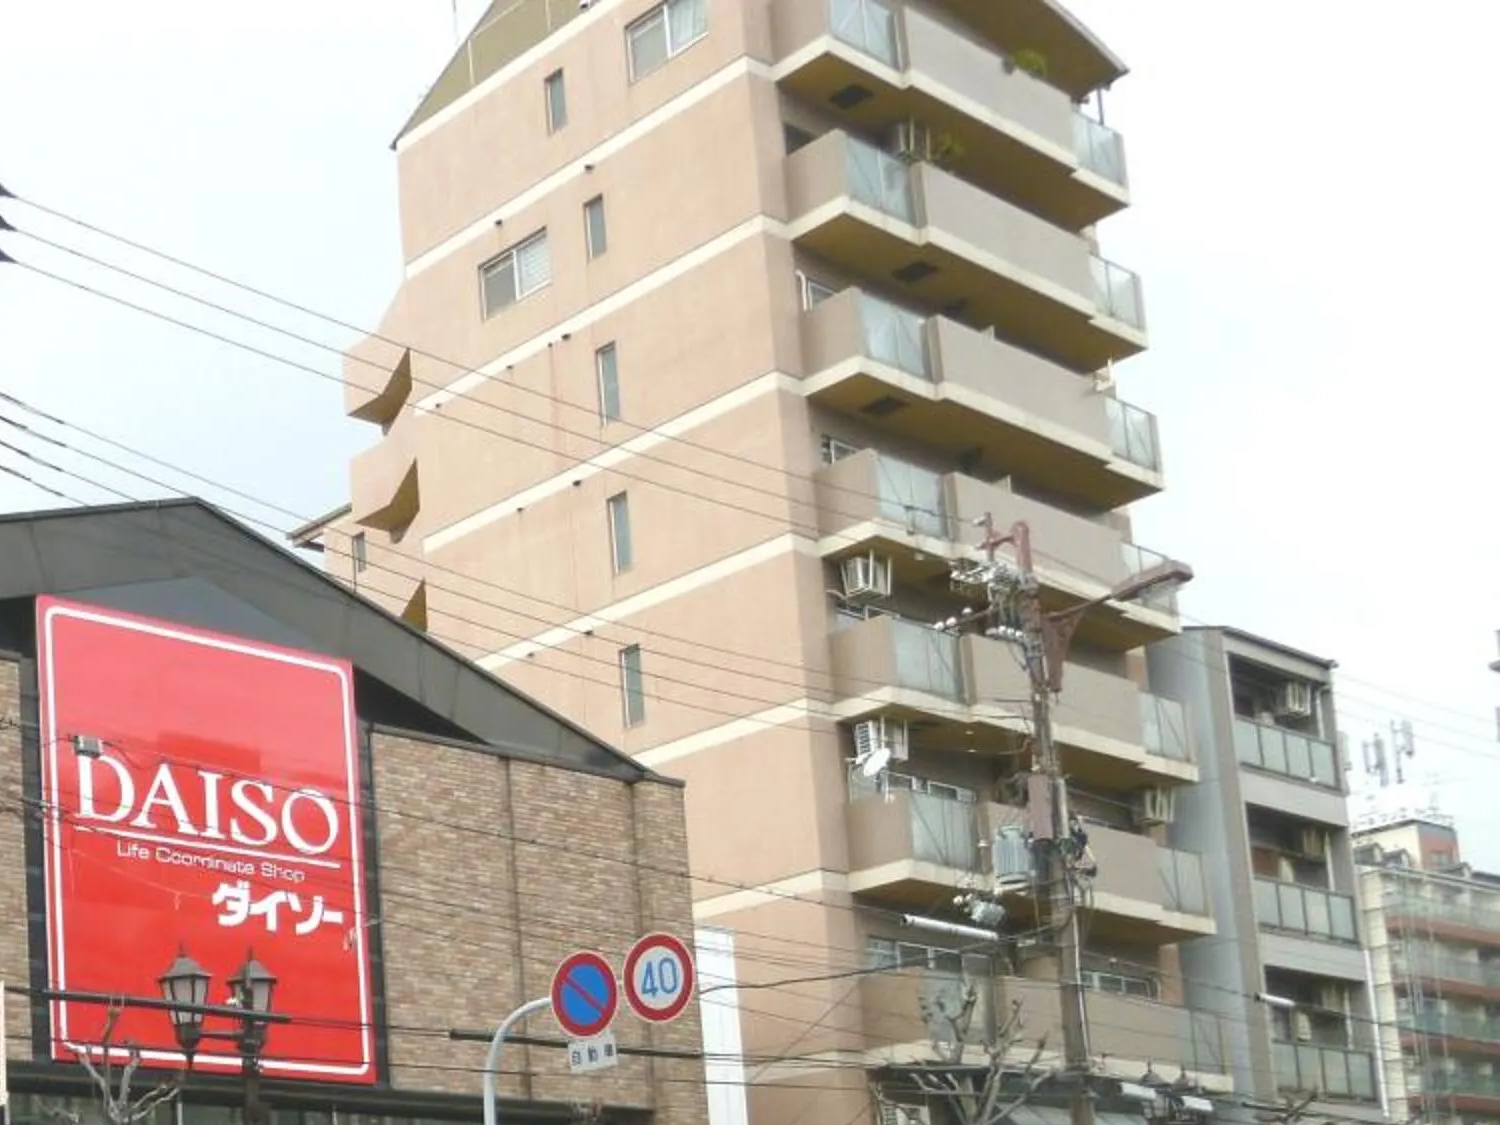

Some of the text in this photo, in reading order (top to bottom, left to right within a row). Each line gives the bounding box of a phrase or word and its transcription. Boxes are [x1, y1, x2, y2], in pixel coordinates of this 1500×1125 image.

[74, 754, 339, 855] DAISO
[116, 840, 150, 858] Life
[260, 863, 305, 883] Shop
[211, 880, 344, 936] ダイソー
[642, 957, 678, 997] 40
